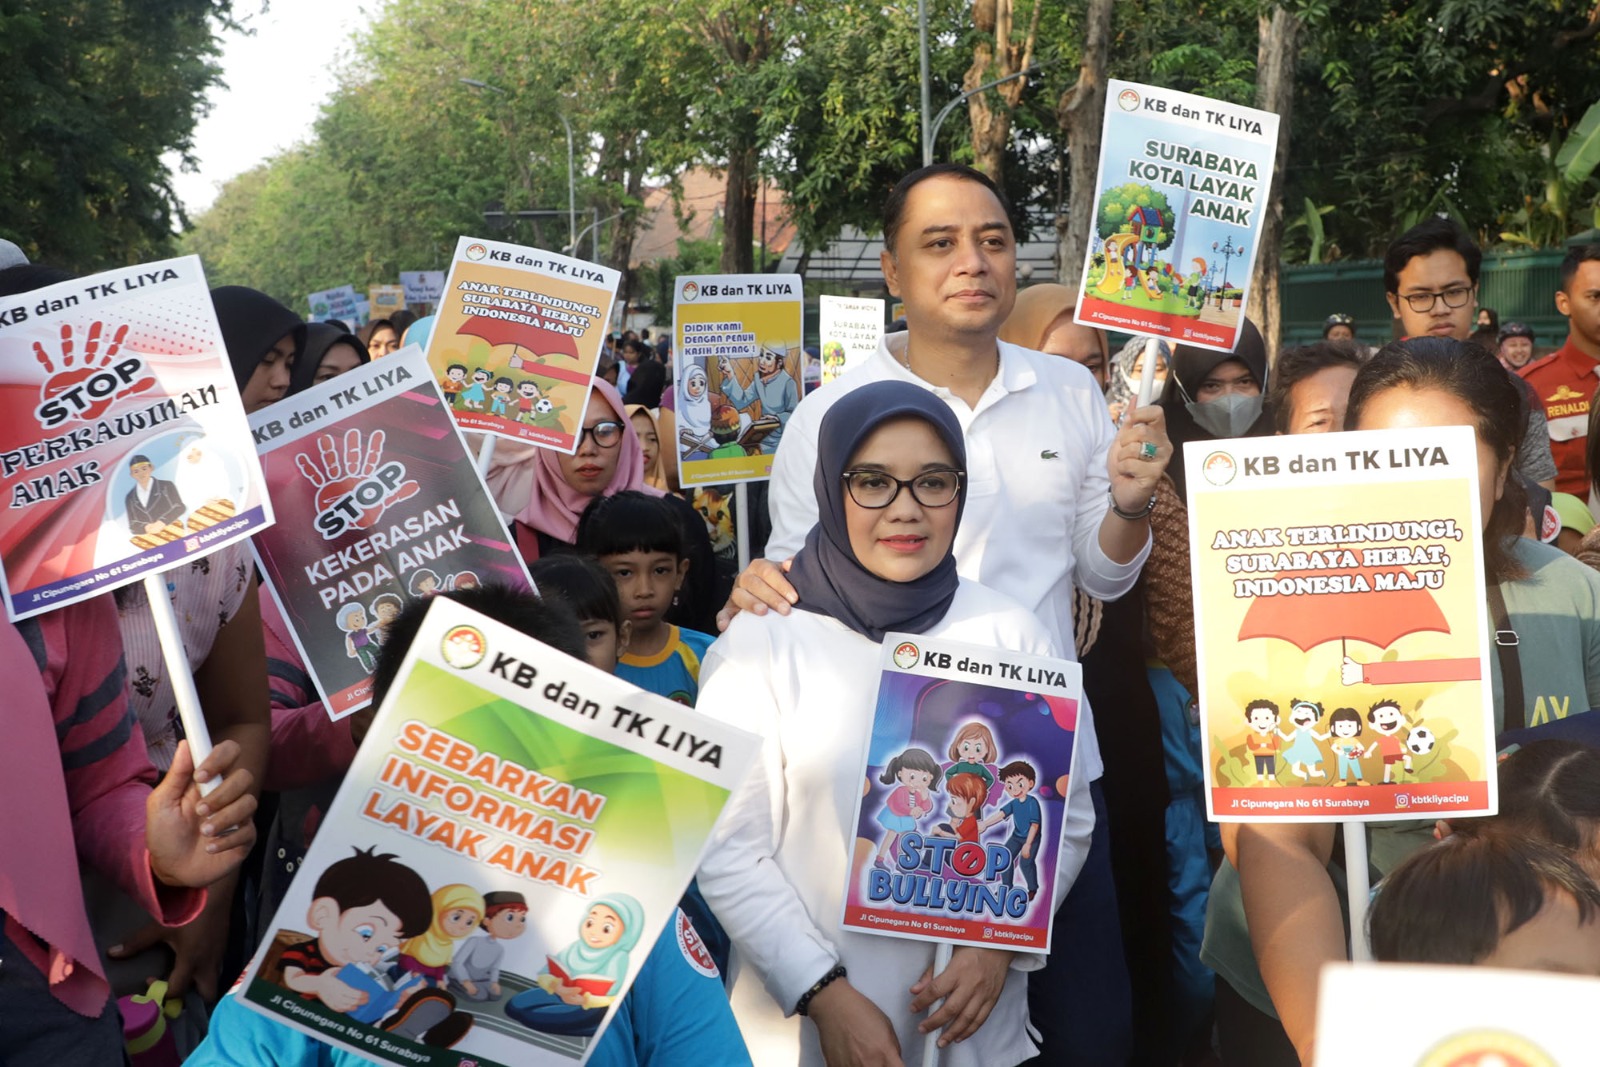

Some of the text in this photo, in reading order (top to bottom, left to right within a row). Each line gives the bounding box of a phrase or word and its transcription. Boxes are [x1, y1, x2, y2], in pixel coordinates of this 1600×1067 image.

[1144, 97, 1262, 135] KB dan TK LIYA
[1146, 140, 1258, 180] SURABAYA
[1129, 160, 1255, 203] KOTA LAYAK
[1190, 198, 1251, 226] ANAK
[490, 250, 605, 283] KB dan TK LIYA
[0, 268, 179, 329] KB dan TK LIYA
[458, 281, 601, 319] ANAK TERLINDUNGI,
[701, 283, 792, 296] KB dan TK LIYA
[462, 293, 590, 329] SURABAYA HEBAT,
[463, 306, 585, 337] INDONESIA MAJU
[684, 323, 741, 333] DIDIK KAMI
[833, 321, 877, 330] SURABAYA
[685, 334, 754, 344] DENGAN PENUH
[685, 346, 712, 355] KASIH
[715, 345, 749, 355] SAYANG
[39, 358, 141, 426] STOP
[252, 365, 413, 445] KB dan TK LIYA
[1, 384, 220, 477] PERKAWINAN
[1244, 446, 1449, 476] KB dan TK LIYA
[11, 461, 102, 508] ANAK
[318, 464, 403, 536] STOP
[304, 499, 461, 585] KEKERASAN
[1211, 519, 1463, 550] ANAK TERLINDUNGI,
[95, 571, 110, 582] No
[109, 567, 122, 577] 61
[318, 524, 472, 610] PADA ANAK
[1226, 545, 1450, 573] SURABAYA HEBAT,
[1234, 570, 1444, 598] INDONESIA MAJU
[924, 651, 1067, 688] KB dan TK LIYA
[489, 652, 724, 769] KB dan TK LIYA
[398, 723, 602, 821] SEBARKAN
[380, 757, 593, 854] INFORMASI
[1240, 799, 1294, 810] Cipunegara
[1296, 799, 1310, 808] No
[1311, 798, 1323, 807] 61
[1325, 798, 1370, 809] Surabaya
[1411, 794, 1469, 806] kbtkliyacipu
[362, 792, 598, 895] LAYAK ANAK
[899, 833, 1011, 881] STOP
[869, 869, 1028, 918] BULLYING
[868, 914, 909, 927] Cipunegara
[911, 920, 922, 928] No
[933, 923, 965, 934] Surabaya
[282, 998, 346, 1034] Cipunegara
[348, 1023, 363, 1040] No
[365, 1032, 379, 1046] 61
[379, 1039, 431, 1064] Surabaya
